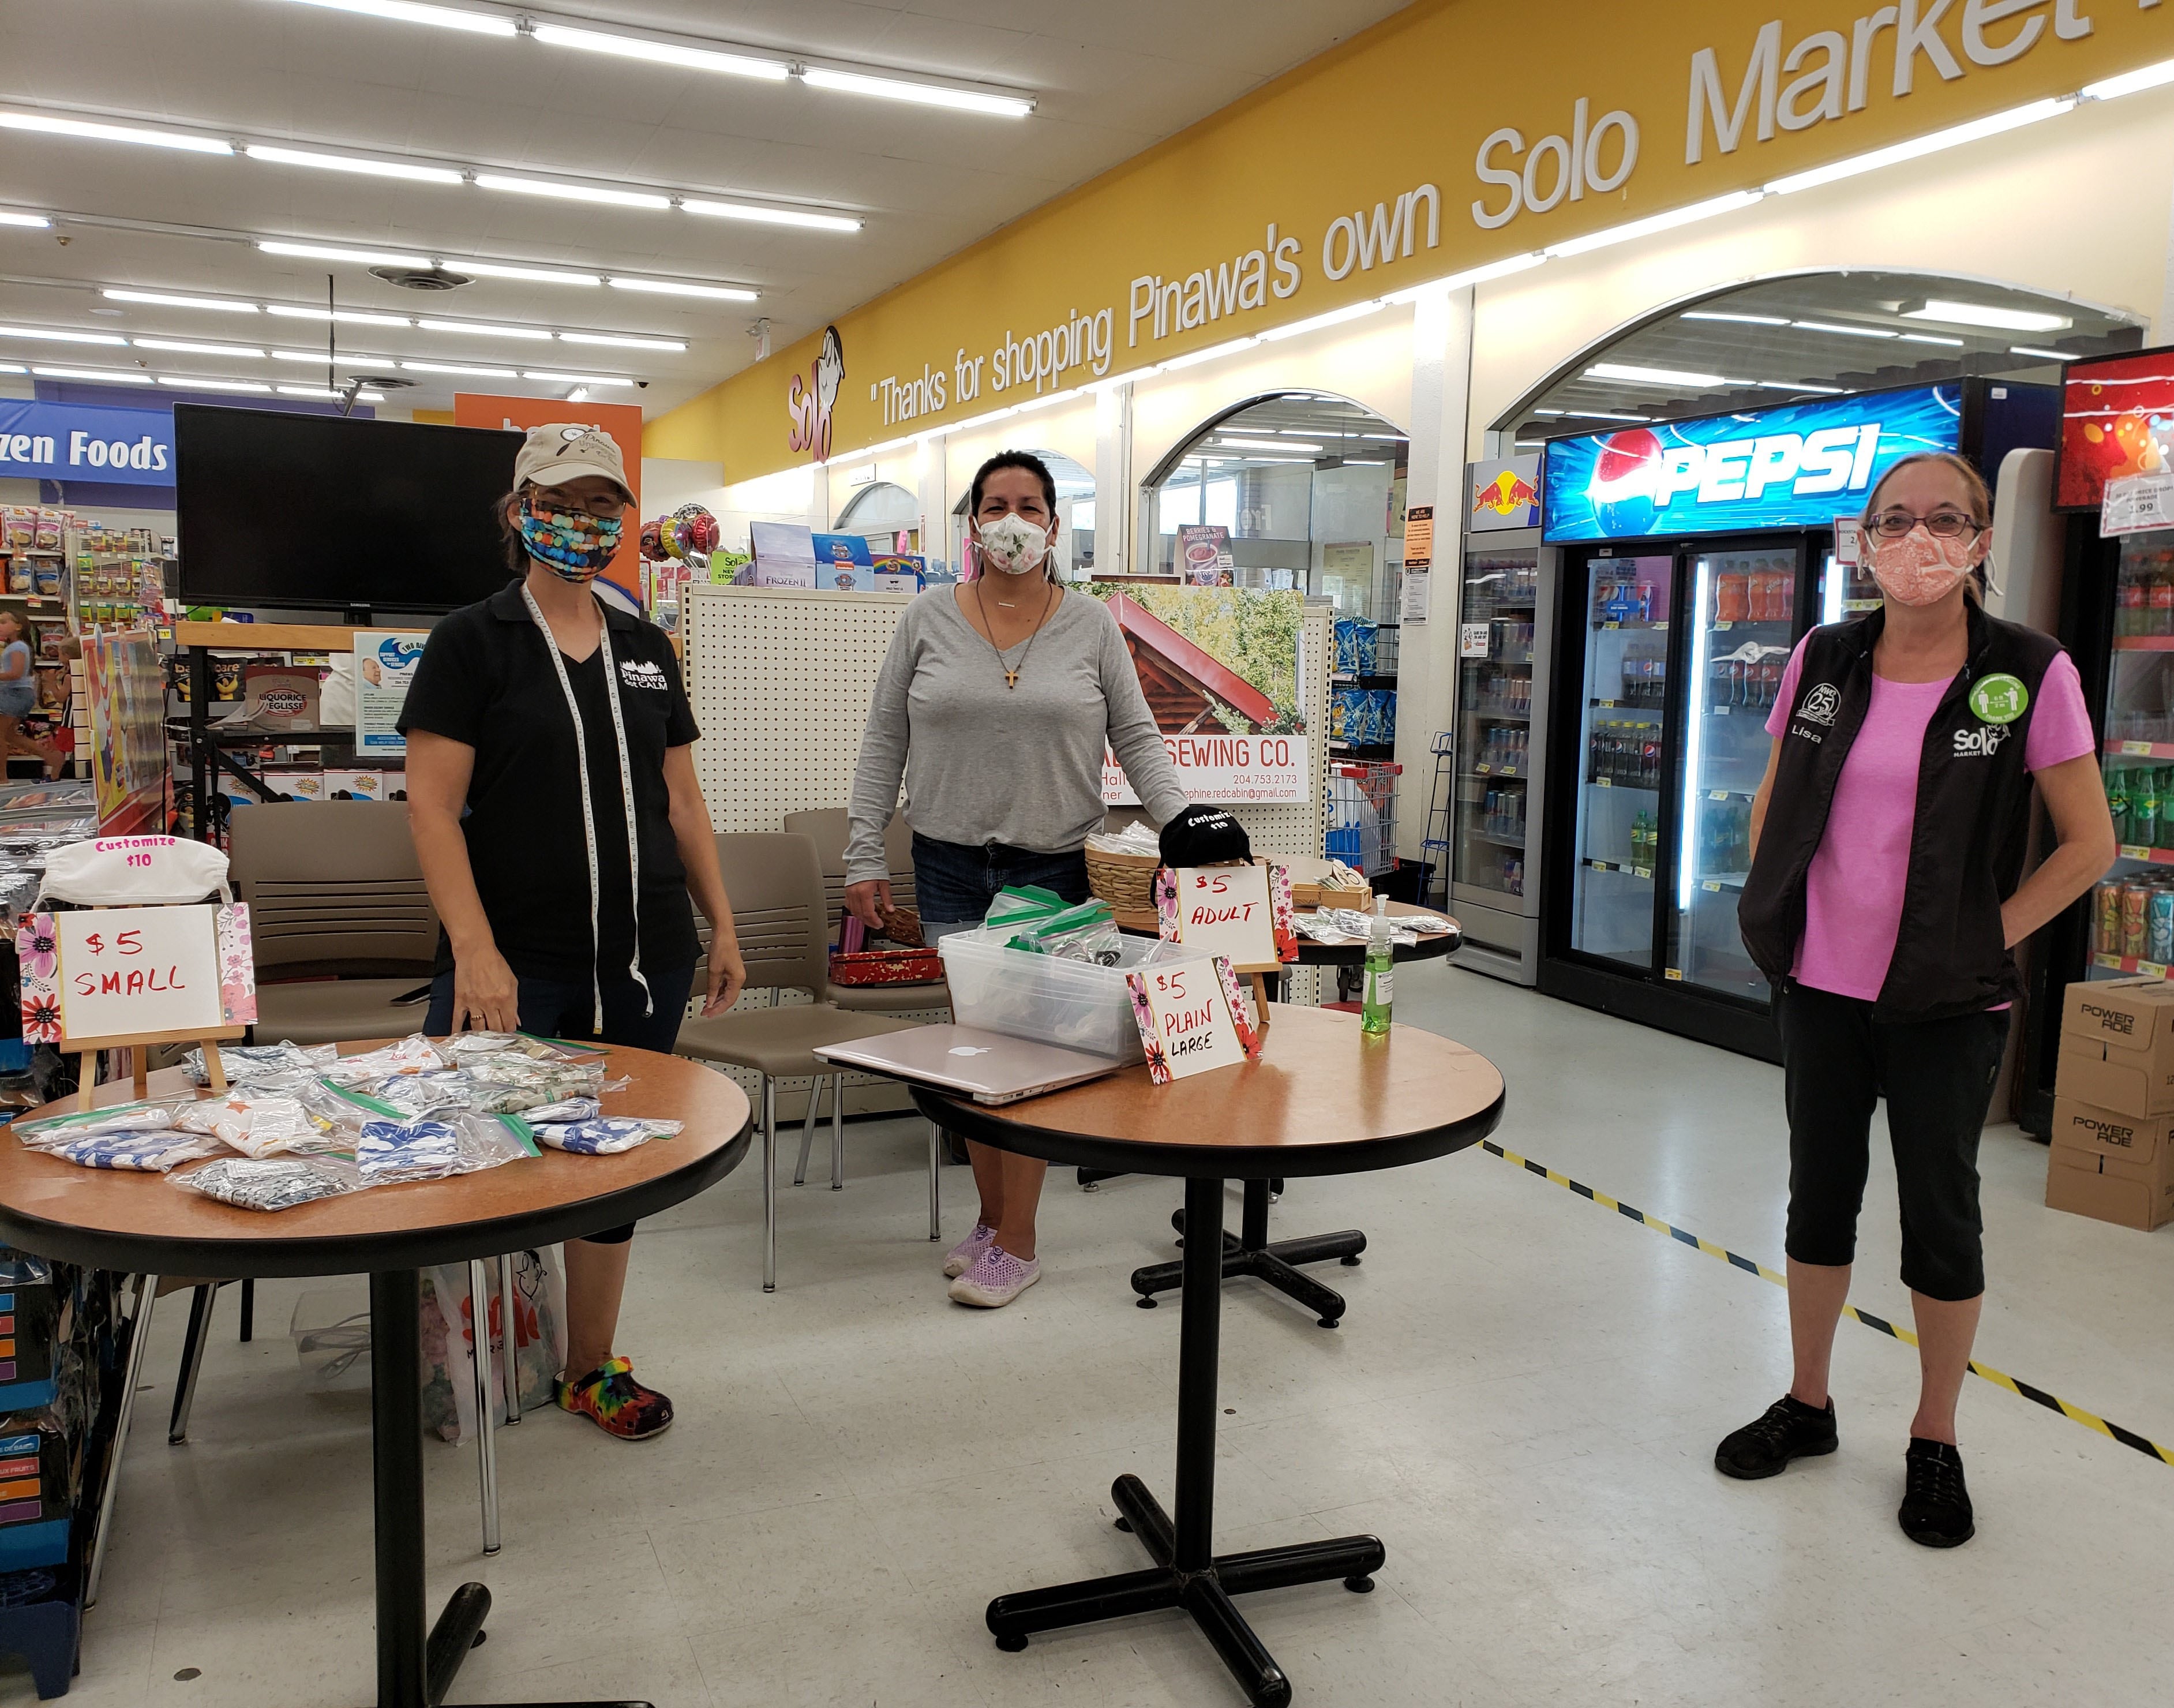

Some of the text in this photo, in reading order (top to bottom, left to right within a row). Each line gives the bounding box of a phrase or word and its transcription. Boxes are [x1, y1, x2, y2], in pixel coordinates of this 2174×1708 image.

[955, 348, 984, 403] for
[991, 306, 1112, 394] shopping
[1129, 223, 1302, 349] Pinawa's
[1322, 182, 1441, 283] own
[1471, 96, 1640, 230] Solo
[1684, 0, 2097, 166] Market
[788, 358, 832, 464] Solo
[69, 430, 168, 471] Foods
[1653, 423, 1881, 507] PEPSI
[1183, 531, 1224, 541] POMEGRANATE
[766, 575, 799, 586] FROZEN
[403, 643, 415, 652] TWO
[620, 668, 666, 683] Pinawa
[638, 681, 668, 691] CALM
[259, 694, 306, 702] LIQUORICE
[1809, 692, 1834, 711] 25
[1791, 725, 1822, 744] Lisa
[1953, 727, 1999, 756] Solo
[1167, 739, 1295, 767] SEWING CO.
[1233, 774, 1297, 785] 204.753.2173
[1210, 821, 1228, 830] $10
[95, 836, 175, 852] Customize
[127, 853, 151, 867] $10
[1191, 902, 1259, 925] ADULT
[74, 966, 185, 995] SMALL
[1157, 972, 1187, 999] $5
[1164, 998, 1213, 1037] PLAIN
[2081, 1003, 2135, 1025] POWER
[2102, 1019, 2132, 1035] ADE
[1171, 1031, 1213, 1057] LARGE
[2073, 1116, 2134, 1137] POWER
[2097, 1132, 2132, 1148] ADE
